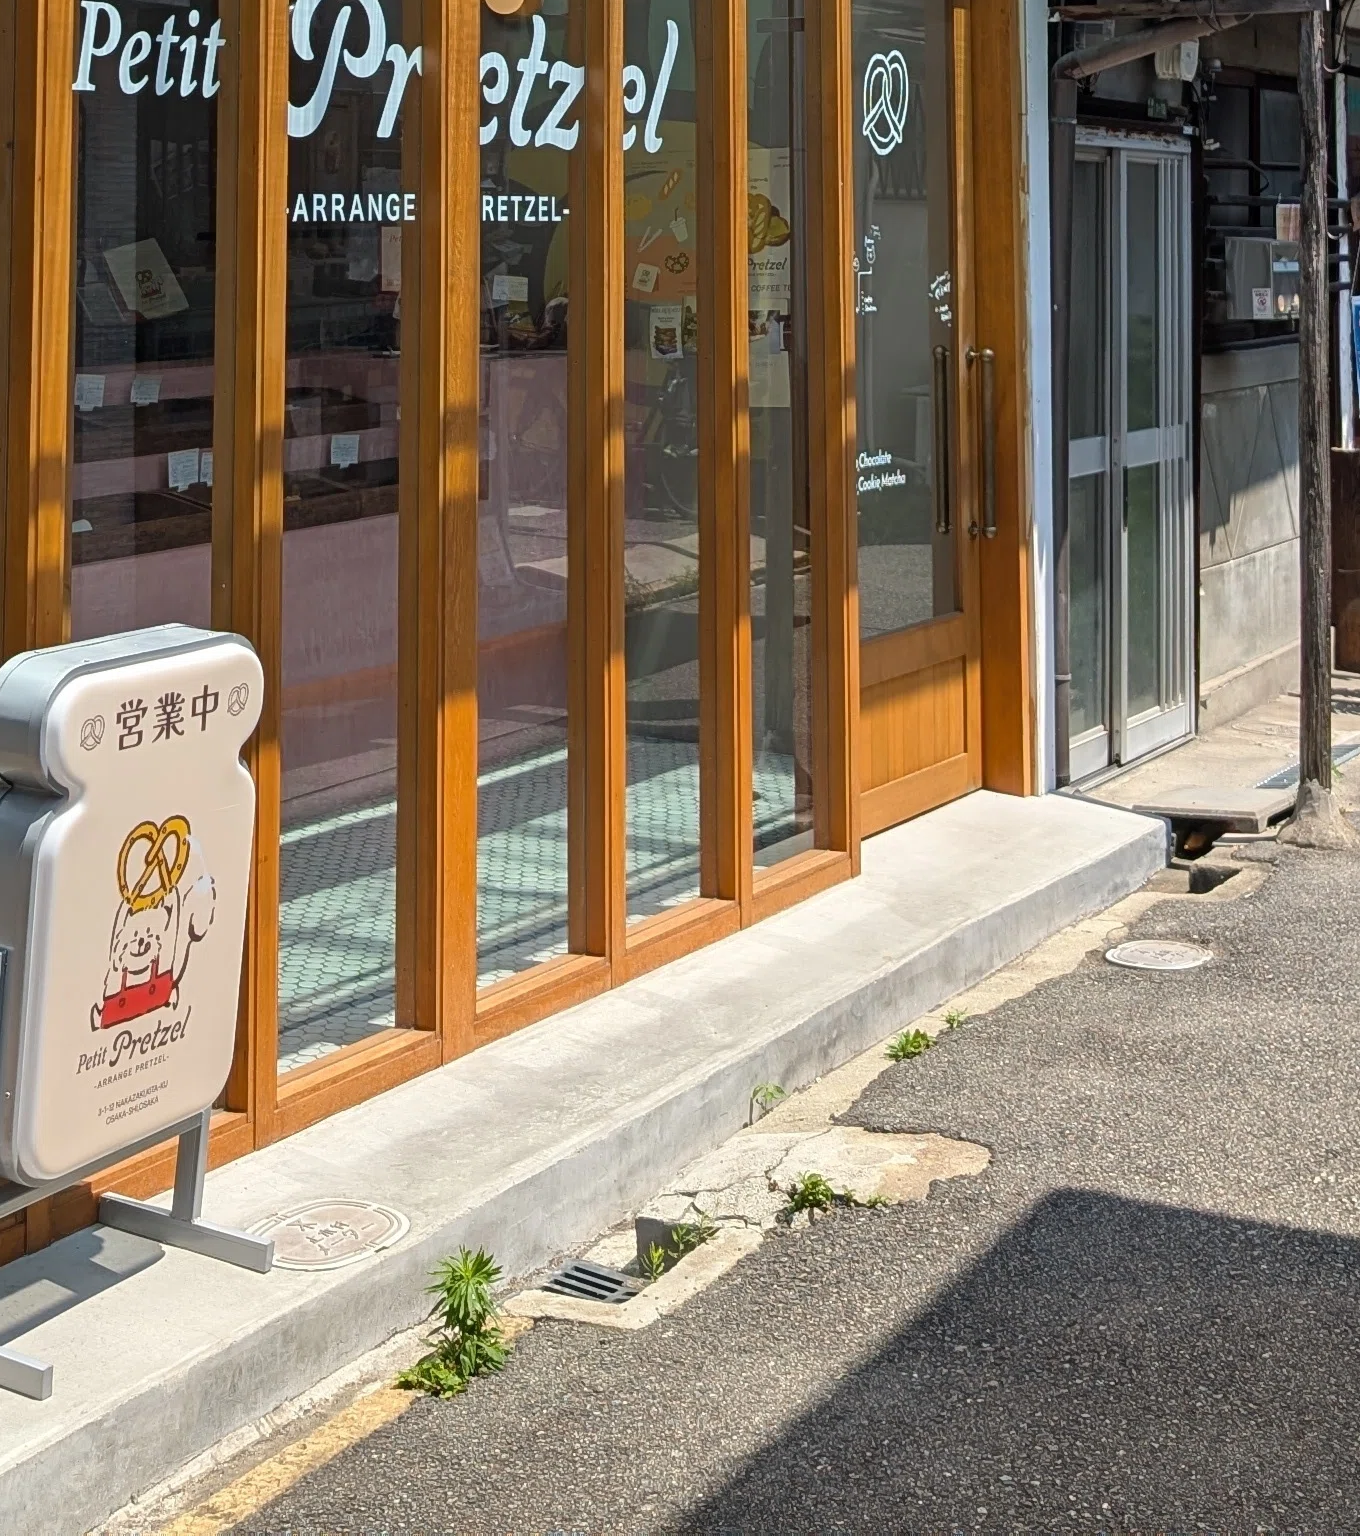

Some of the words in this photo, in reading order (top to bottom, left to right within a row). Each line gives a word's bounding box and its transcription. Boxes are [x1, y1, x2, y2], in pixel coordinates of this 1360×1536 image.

[71, 0, 227, 99] Petit
[481, 195, 570, 222] RETZEL-
[116, 683, 220, 751] 営業中
[76, 1046, 108, 1075] Petit
[109, 1005, 192, 1067] Pretzel
[94, 1067, 133, 1089] -ARRANGE
[134, 1054, 170, 1075] PRETZEL-
